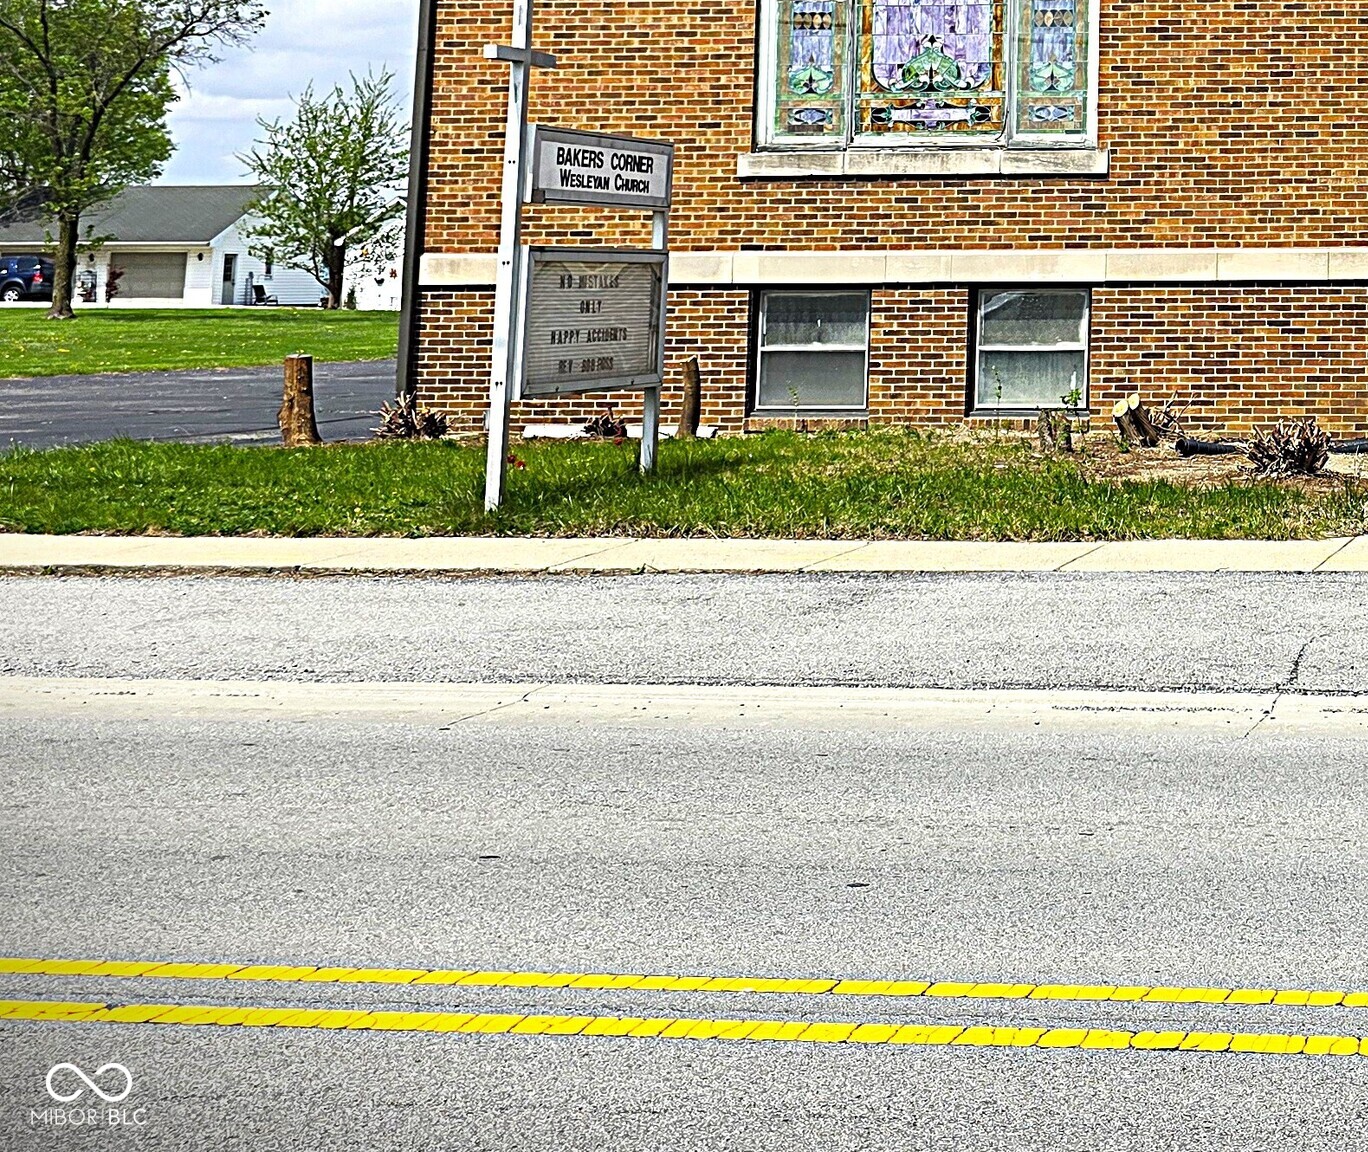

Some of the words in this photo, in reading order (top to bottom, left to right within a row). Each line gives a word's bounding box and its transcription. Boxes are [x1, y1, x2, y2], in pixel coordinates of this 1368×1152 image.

[556, 146, 604, 169] BAKERS
[610, 152, 654, 174] CORNER
[559, 274, 573, 289] NO
[578, 274, 619, 289] MISTAKES
[579, 300, 602, 314] ONLY
[550, 330, 580, 345] HAPPY
[586, 327, 628, 343] ACCIDENTS
